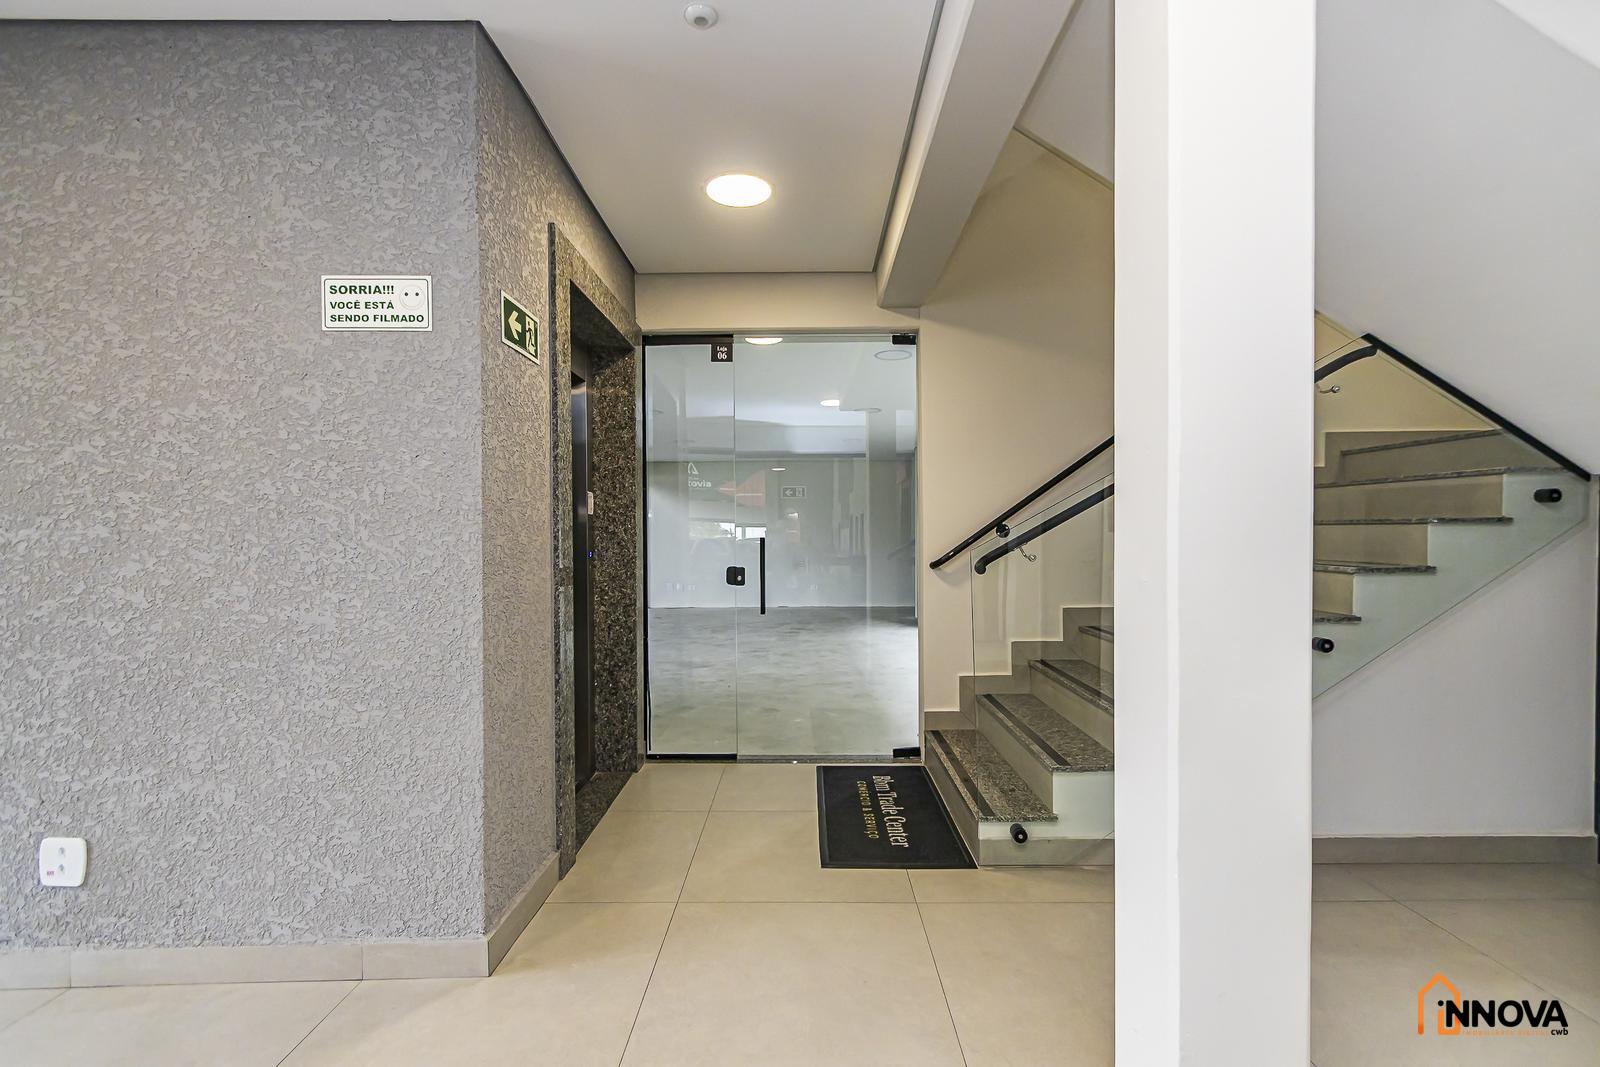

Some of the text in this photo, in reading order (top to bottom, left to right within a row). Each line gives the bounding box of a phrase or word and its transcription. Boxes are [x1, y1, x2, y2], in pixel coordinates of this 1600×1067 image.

[329, 285, 395, 295] SORRIA!!!
[330, 300, 395, 309] VOCÊ ESTÁ
[330, 314, 425, 323] SENDO FILMADO
[717, 351, 728, 360] 06
[877, 791, 905, 815] Trade
[883, 816, 909, 848] Center
